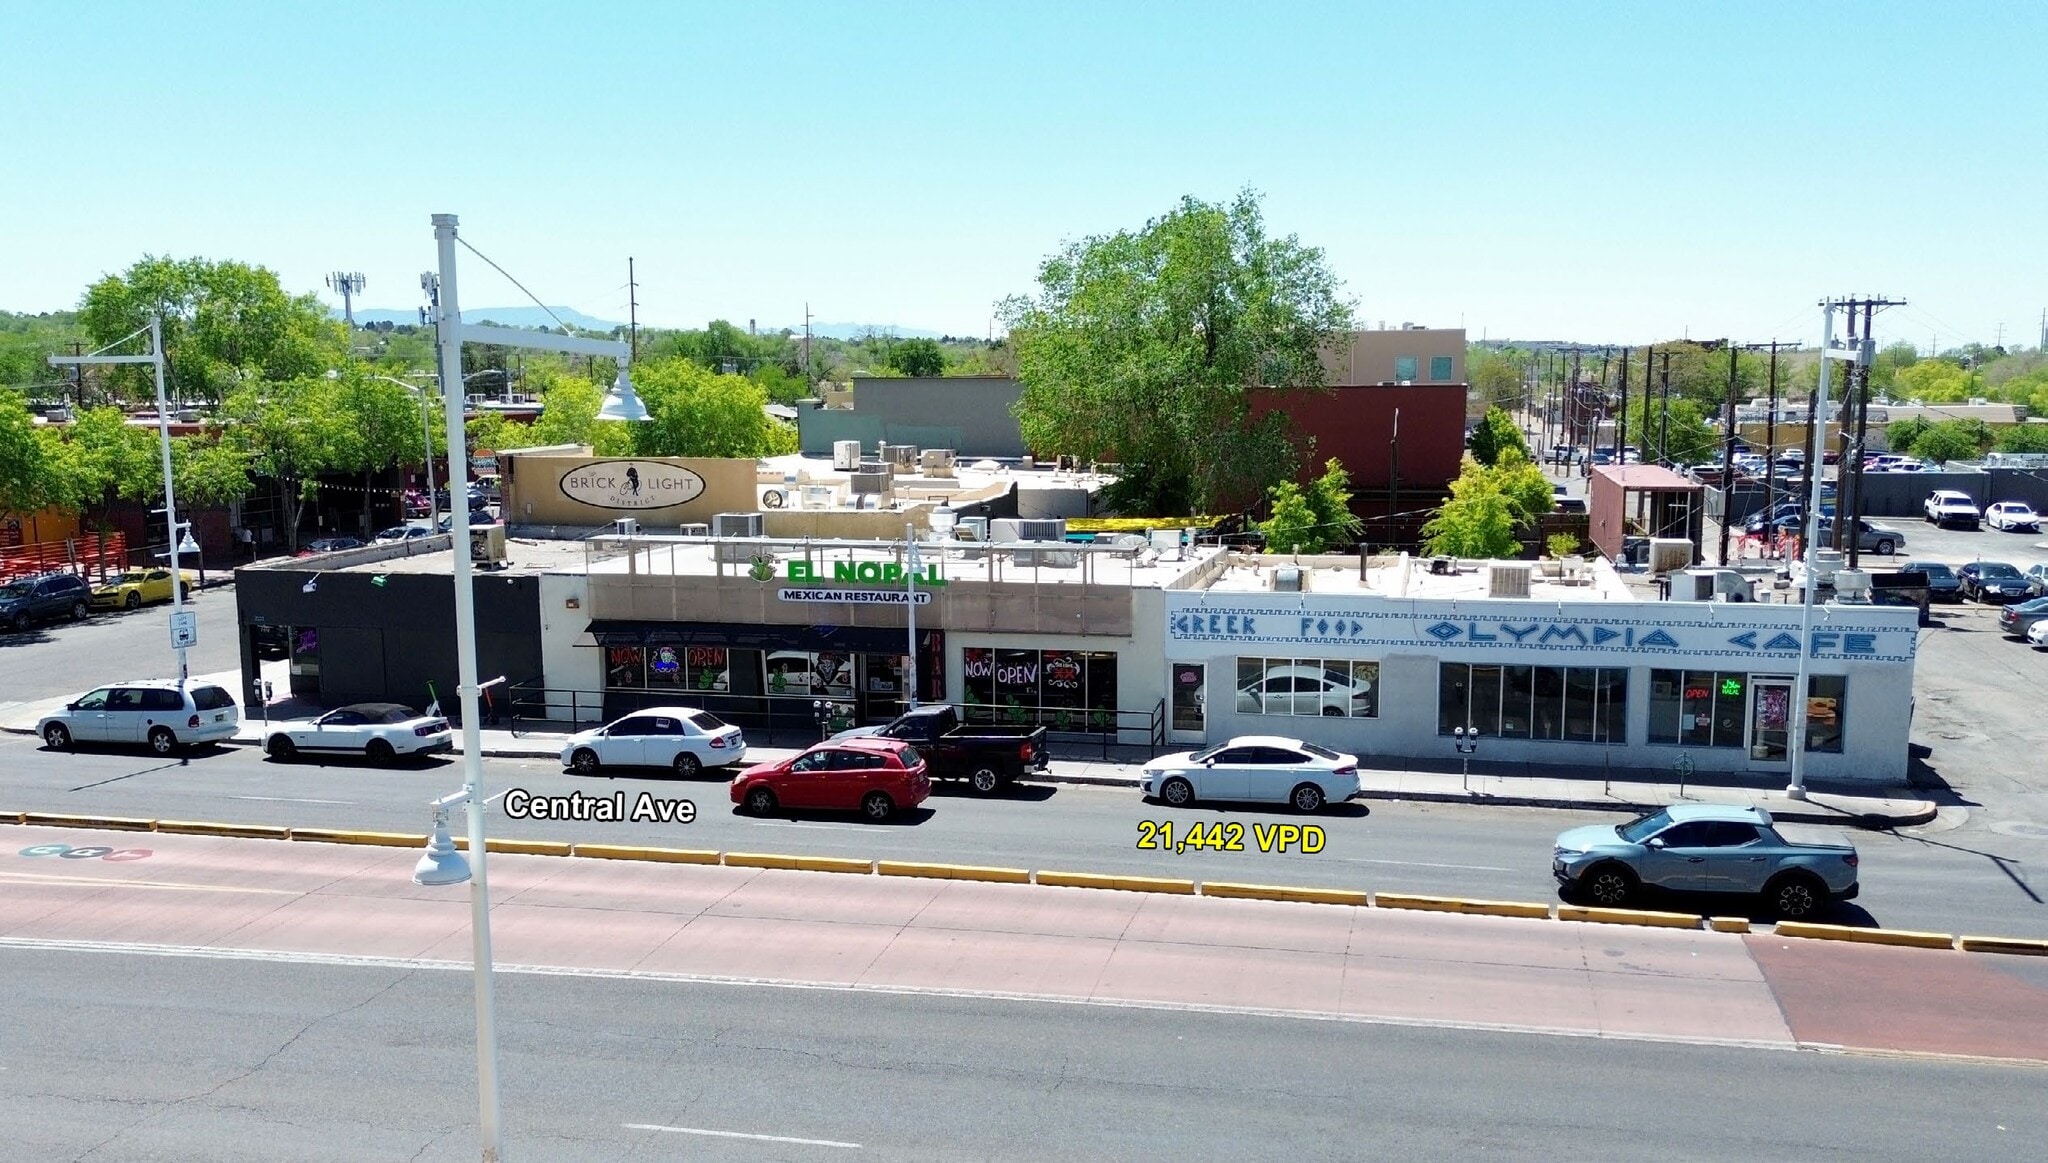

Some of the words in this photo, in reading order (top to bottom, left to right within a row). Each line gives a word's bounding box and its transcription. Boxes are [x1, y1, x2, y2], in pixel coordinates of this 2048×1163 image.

[570, 477, 616, 489] BRICK
[648, 478, 693, 490] LIGHT
[788, 560, 825, 584] EL
[784, 591, 842, 600] MEXICAN
[845, 592, 927, 603] RESTAURANT
[1176, 614, 1256, 635] GREEK
[1301, 617, 1364, 637] FOOD
[1425, 621, 1680, 647] OLYMPIA
[1728, 631, 1876, 653] CAFE
[611, 648, 645, 665] NOW
[688, 648, 724, 666] OPEN
[965, 661, 995, 677] NOW
[998, 664, 1038, 684] OPEN
[1685, 688, 1709, 698] OPEN
